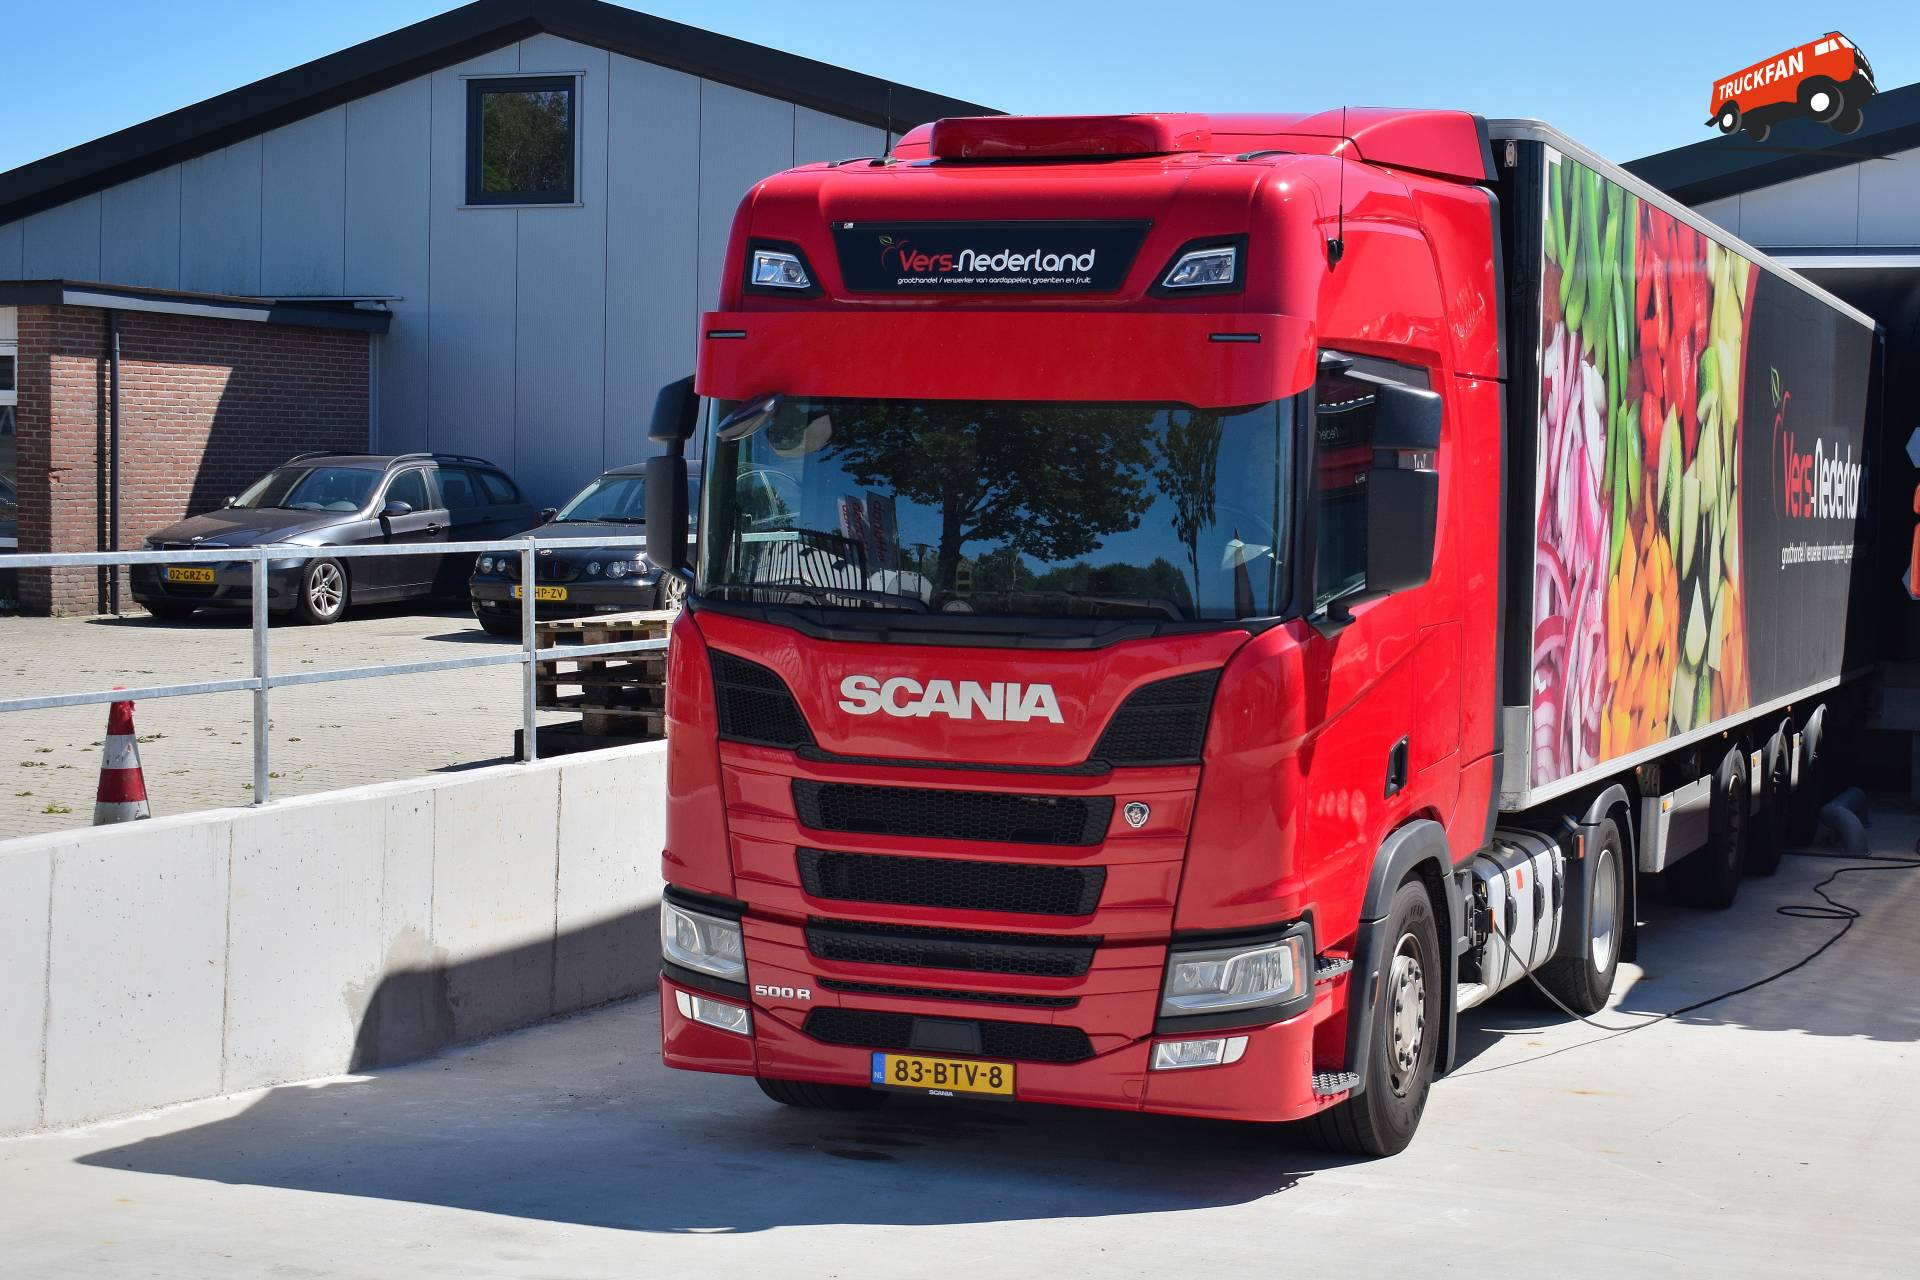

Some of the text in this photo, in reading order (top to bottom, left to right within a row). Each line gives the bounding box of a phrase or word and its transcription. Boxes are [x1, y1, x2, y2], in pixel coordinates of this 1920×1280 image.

[899, 248, 1096, 272] Vers-Nederland
[897, 276, 938, 285] groothandel
[943, 276, 975, 284] verwerker
[988, 276, 1031, 284] aardappelen,
[1032, 276, 1064, 285] groenten
[1075, 276, 1091, 285] fruit
[1783, 430, 1866, 520] Vers-Nederlan
[169, 569, 211, 581] 02-GRZ-6
[518, 587, 563, 599] 5HP-ZV
[838, 674, 1065, 724] SCANIA
[755, 984, 811, 1001] 500 R
[872, 1071, 884, 1079] NL
[895, 1059, 1003, 1088] 83-BTV-8
[928, 1089, 954, 1097] SCANIA
